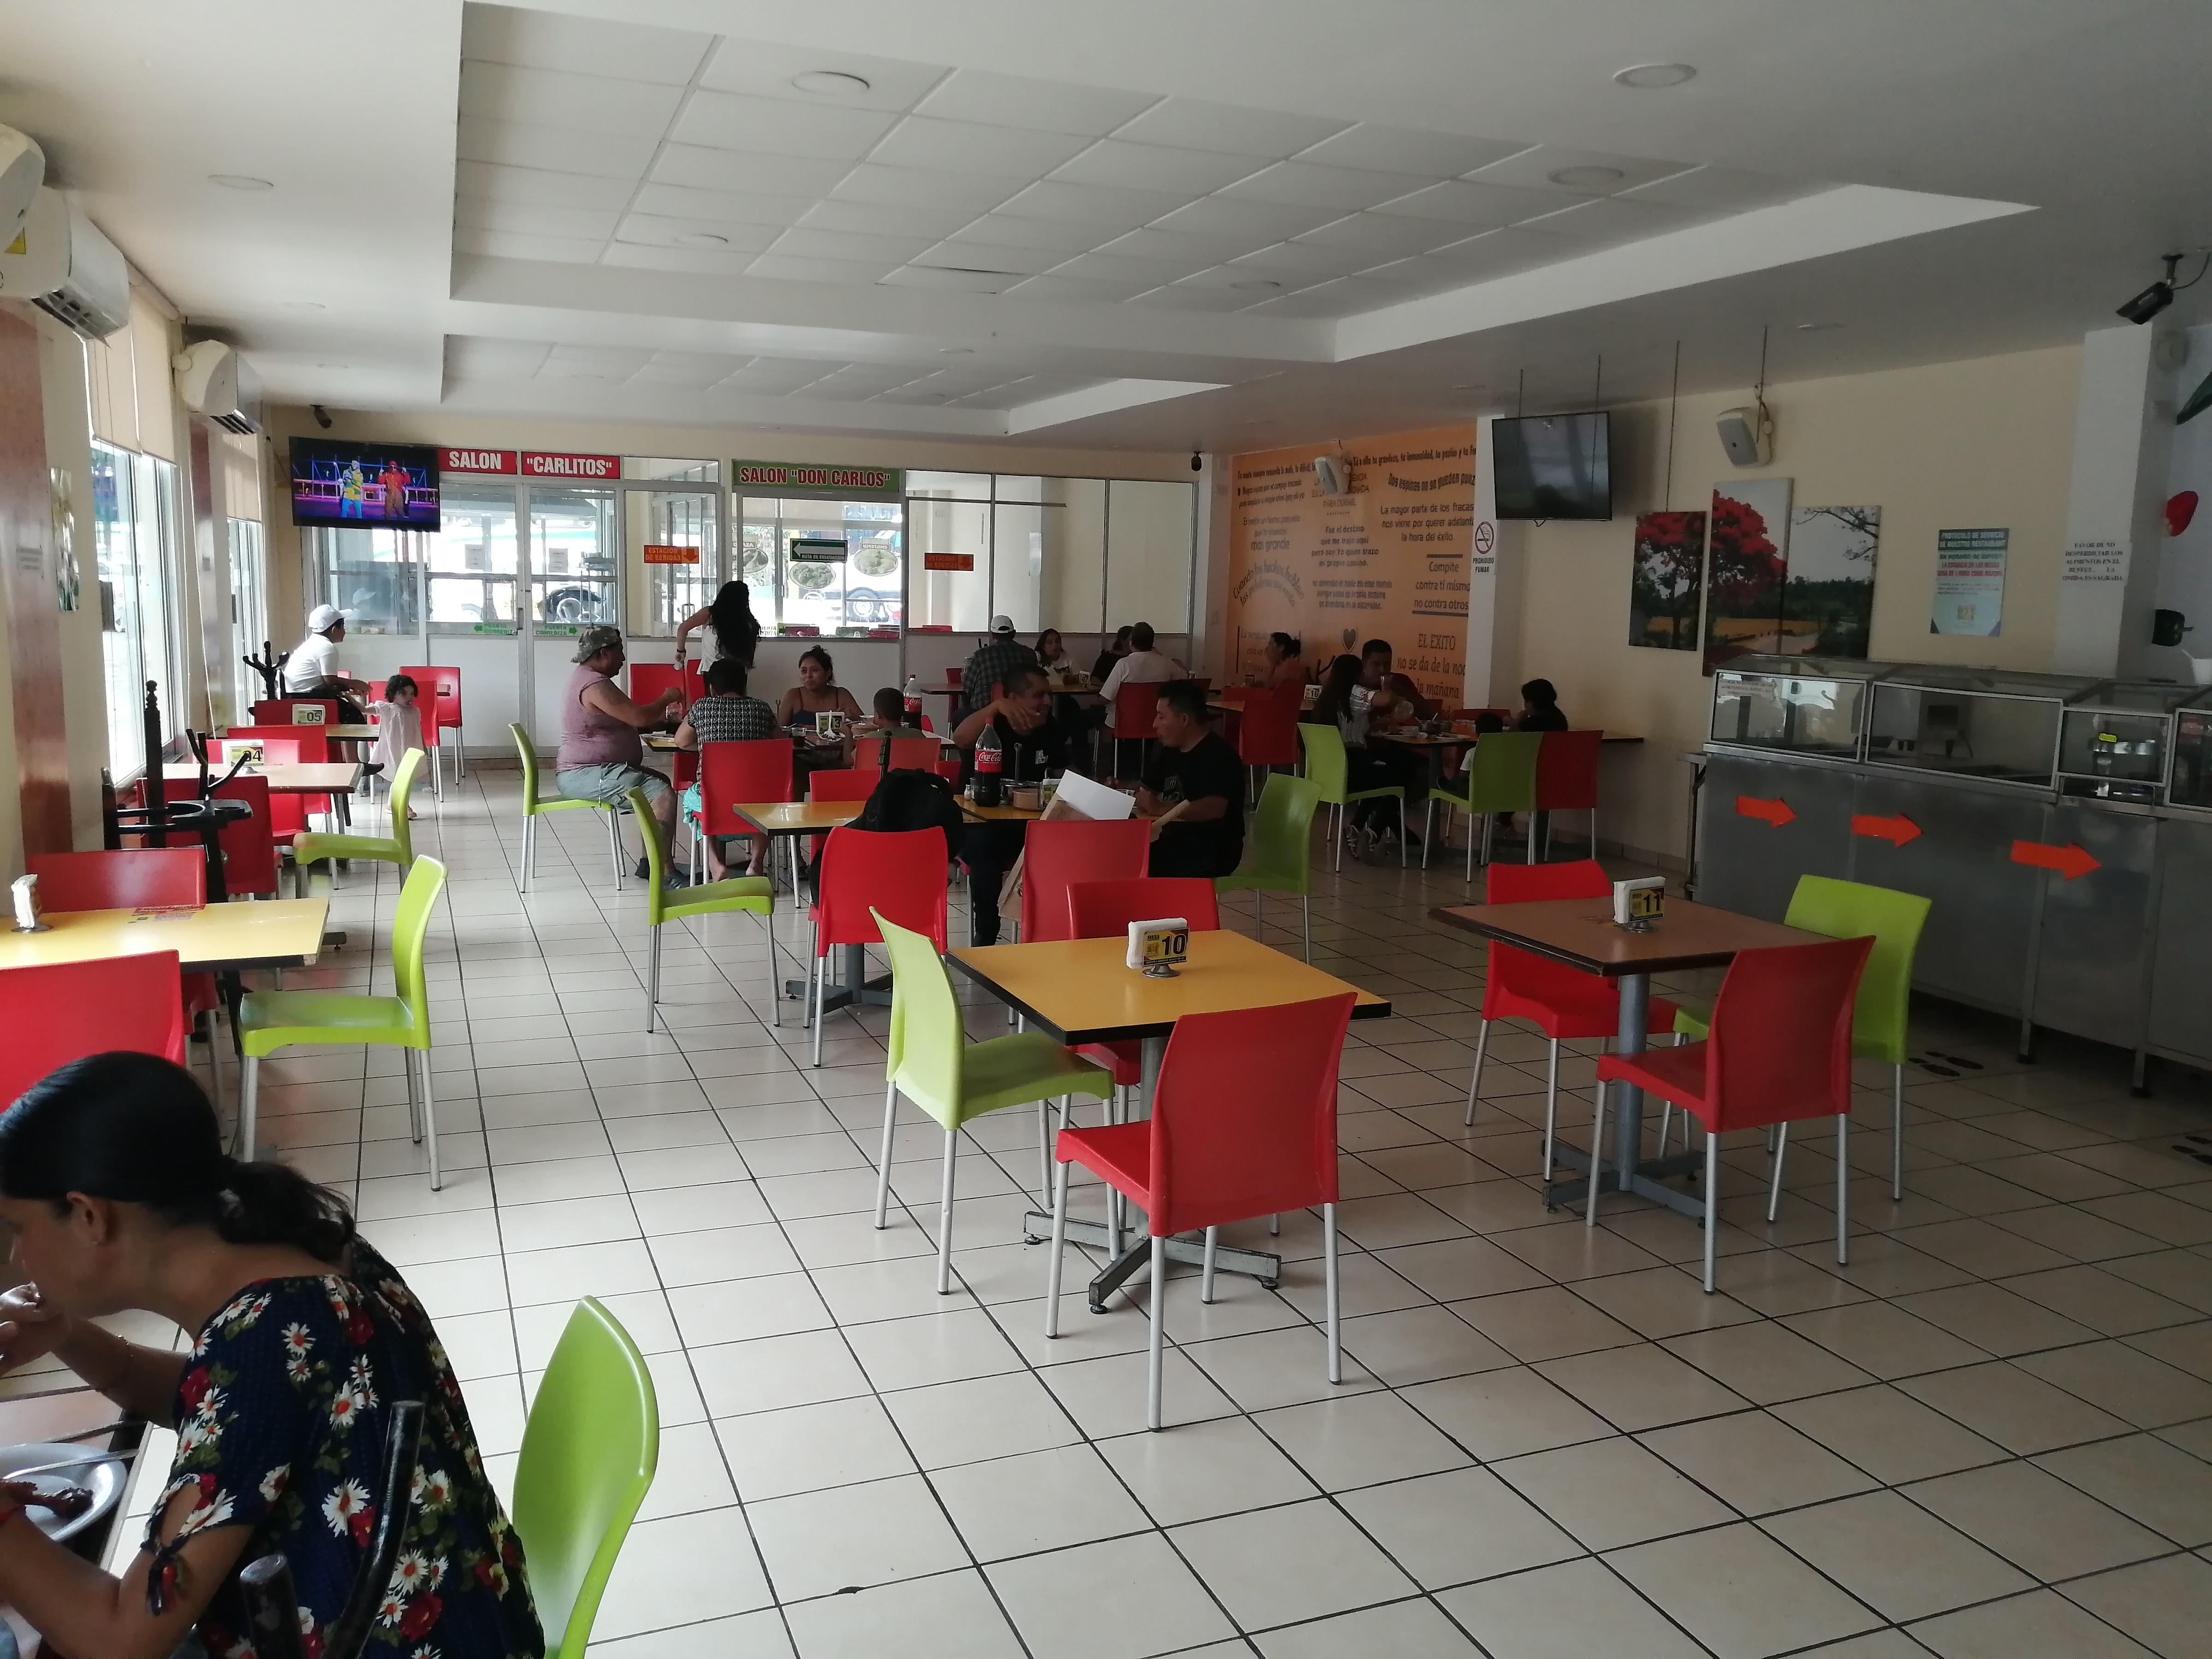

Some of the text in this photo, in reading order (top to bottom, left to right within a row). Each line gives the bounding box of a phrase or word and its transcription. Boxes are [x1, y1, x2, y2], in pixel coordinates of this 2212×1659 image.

[449, 452, 501, 470] SALON
[526, 457, 612, 476] "CARLITOS"
[741, 467, 890, 488] SALON "DON CARLOS"
[1438, 472, 1459, 489] pueden
[1461, 474, 1476, 486] punz
[1381, 506, 1388, 514] La
[1391, 506, 1409, 515] mayor
[1412, 504, 1427, 514] parte
[1430, 503, 1437, 512] de
[1453, 502, 1474, 511] fracas
[1395, 519, 1411, 528] viene
[1413, 520, 1423, 529] por
[1426, 519, 1445, 529] querer
[1447, 517, 1474, 527] adelant
[1402, 533, 1406, 541] la
[1409, 532, 1423, 541] hora
[1426, 532, 1435, 541] del
[1429, 561, 1459, 574] Compite
[1416, 580, 1471, 591] contra ti mismo
[1414, 599, 1469, 610] no contra otros
[1418, 634, 1456, 650] EL EXITO
[1397, 655, 1449, 674] no se da de la
[1417, 678, 1459, 699] la mañana
[306, 712, 321, 722] 05
[1643, 891, 1661, 913] 11
[1161, 933, 1187, 956] 10
